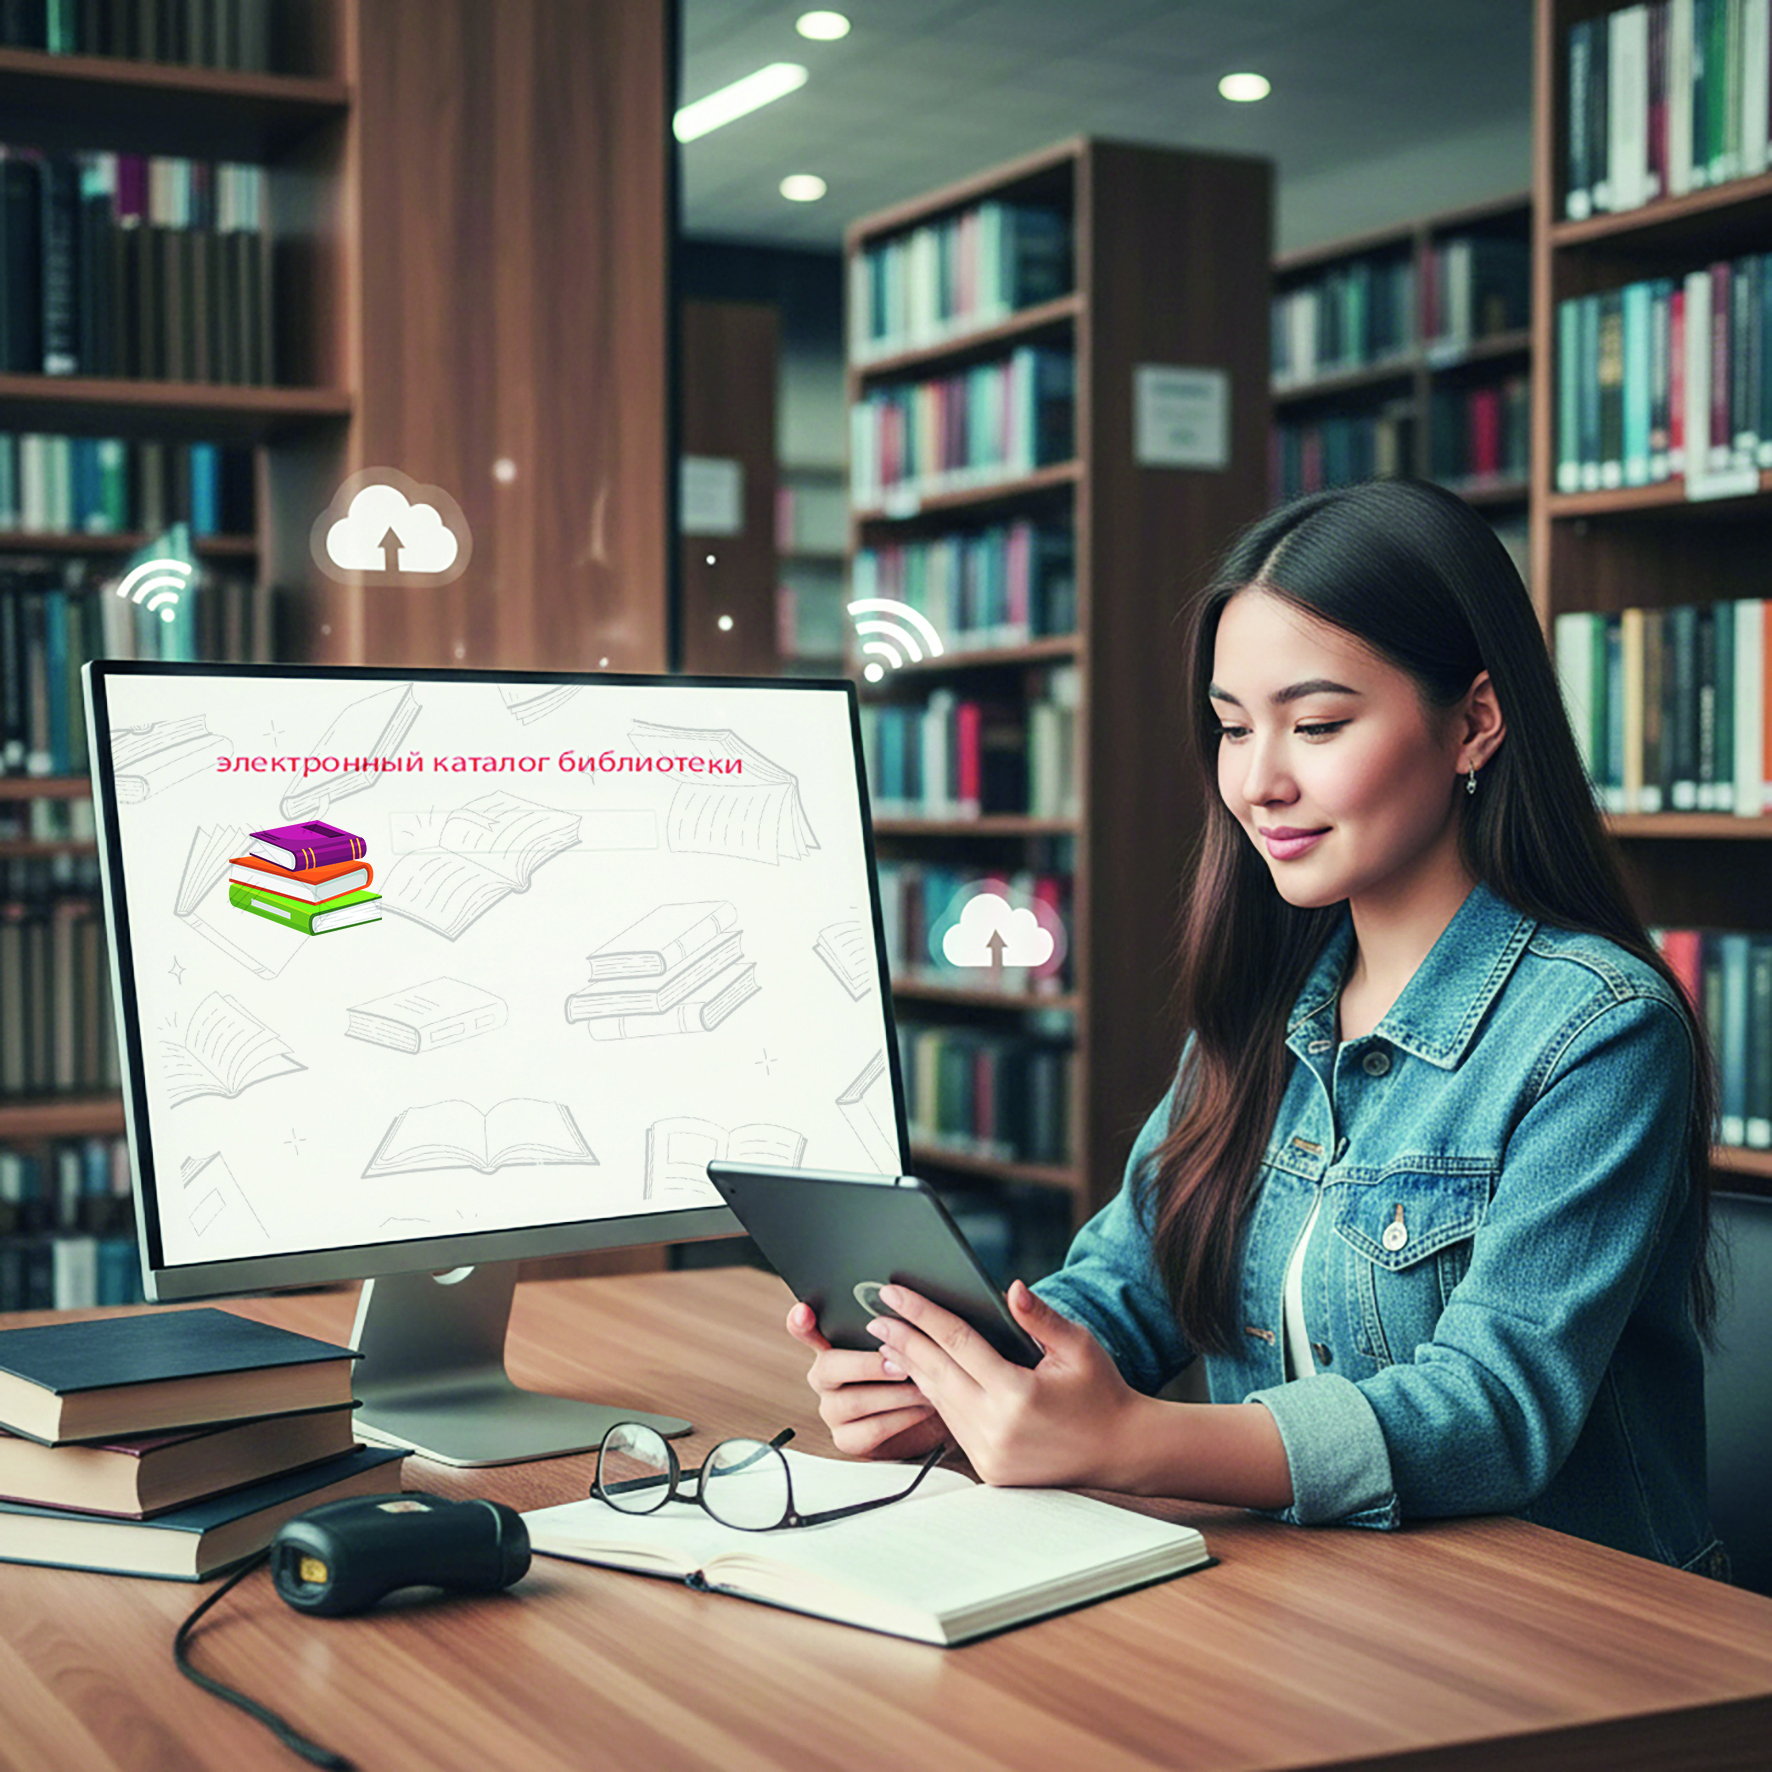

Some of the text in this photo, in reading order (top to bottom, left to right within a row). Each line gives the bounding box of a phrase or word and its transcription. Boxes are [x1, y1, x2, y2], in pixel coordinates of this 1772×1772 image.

[216, 749, 743, 777] электронный каталог библиотеки
